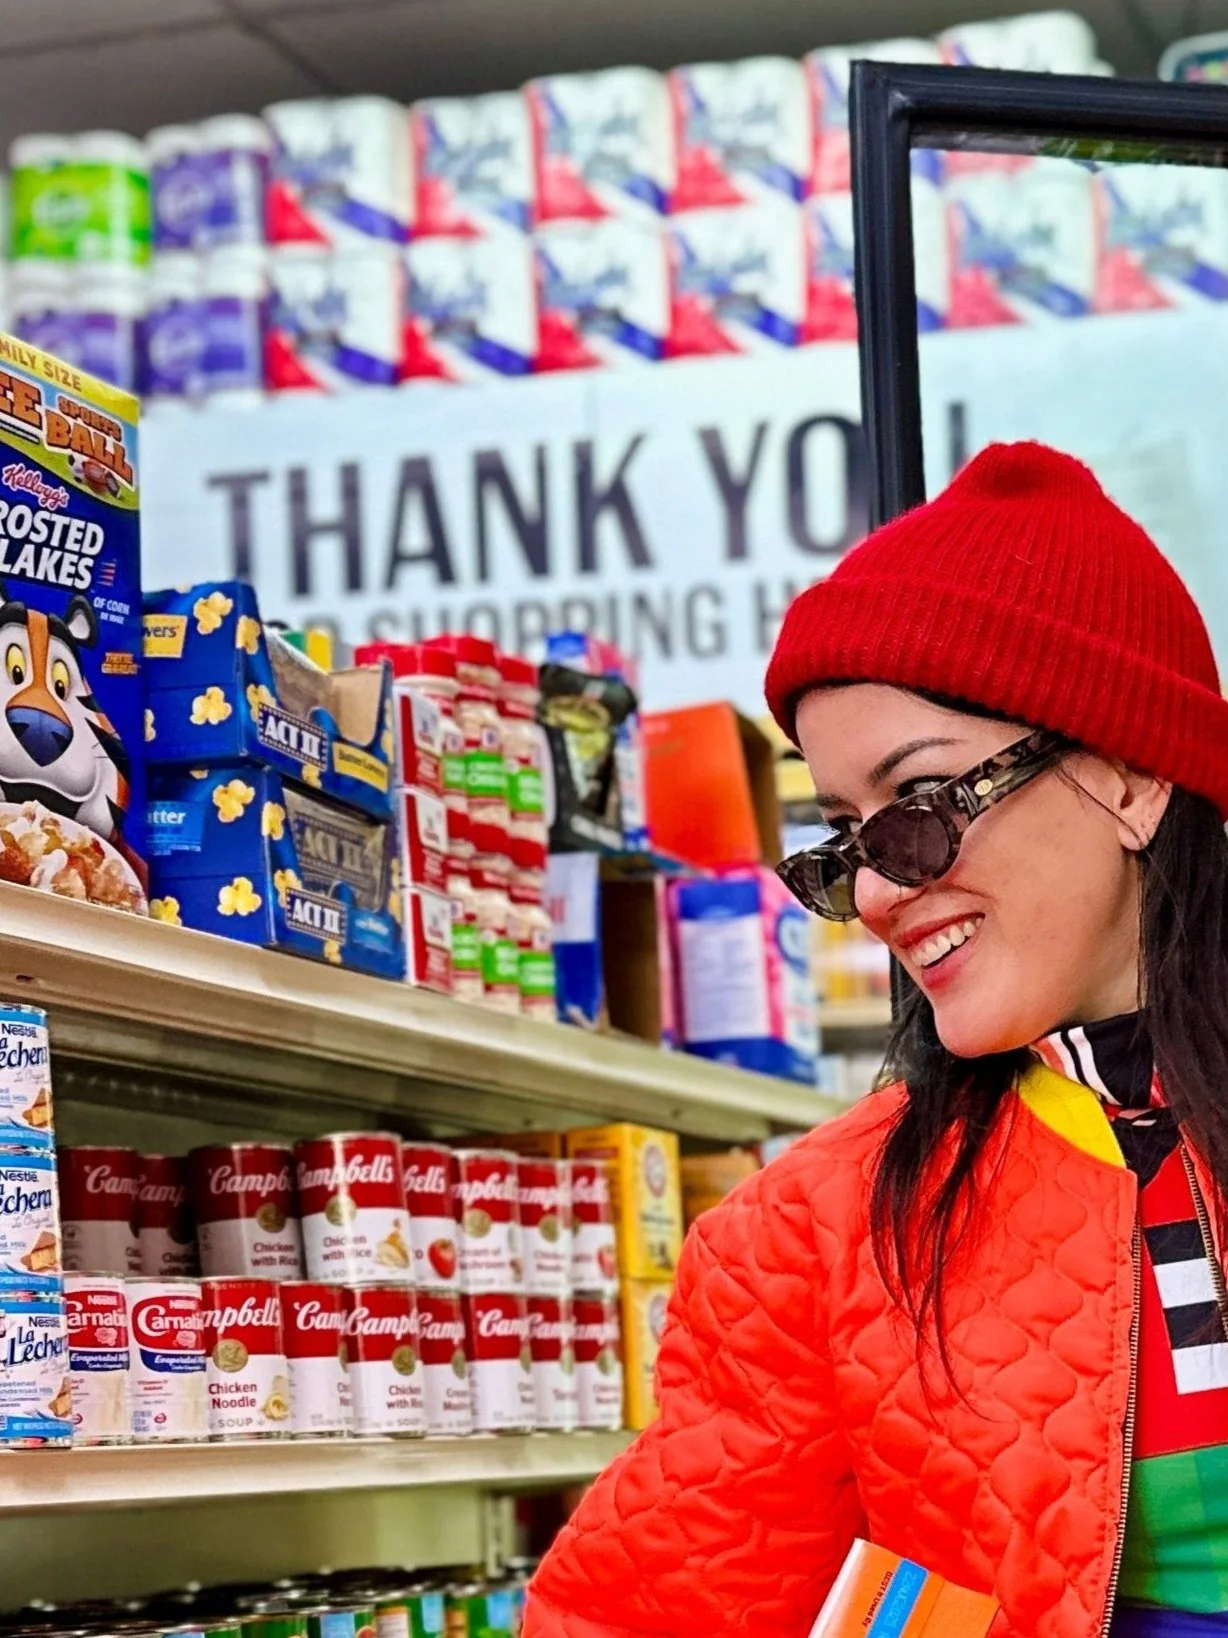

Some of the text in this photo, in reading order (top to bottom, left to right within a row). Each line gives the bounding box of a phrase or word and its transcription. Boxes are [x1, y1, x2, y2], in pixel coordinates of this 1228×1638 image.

[43, 361, 83, 392] SIZE
[45, 408, 133, 487] BALL
[2, 463, 69, 509] Kellogg's
[206, 432, 655, 598] THANK
[263, 717, 298, 751] ACT
[292, 901, 321, 927] ACT
[322, 1235, 367, 1249] Chicen
[18, 1325, 35, 1344] La
[208, 1383, 257, 1395] Chicken
[211, 1395, 257, 1409] Noodle
[218, 1417, 253, 1429] SOUP
